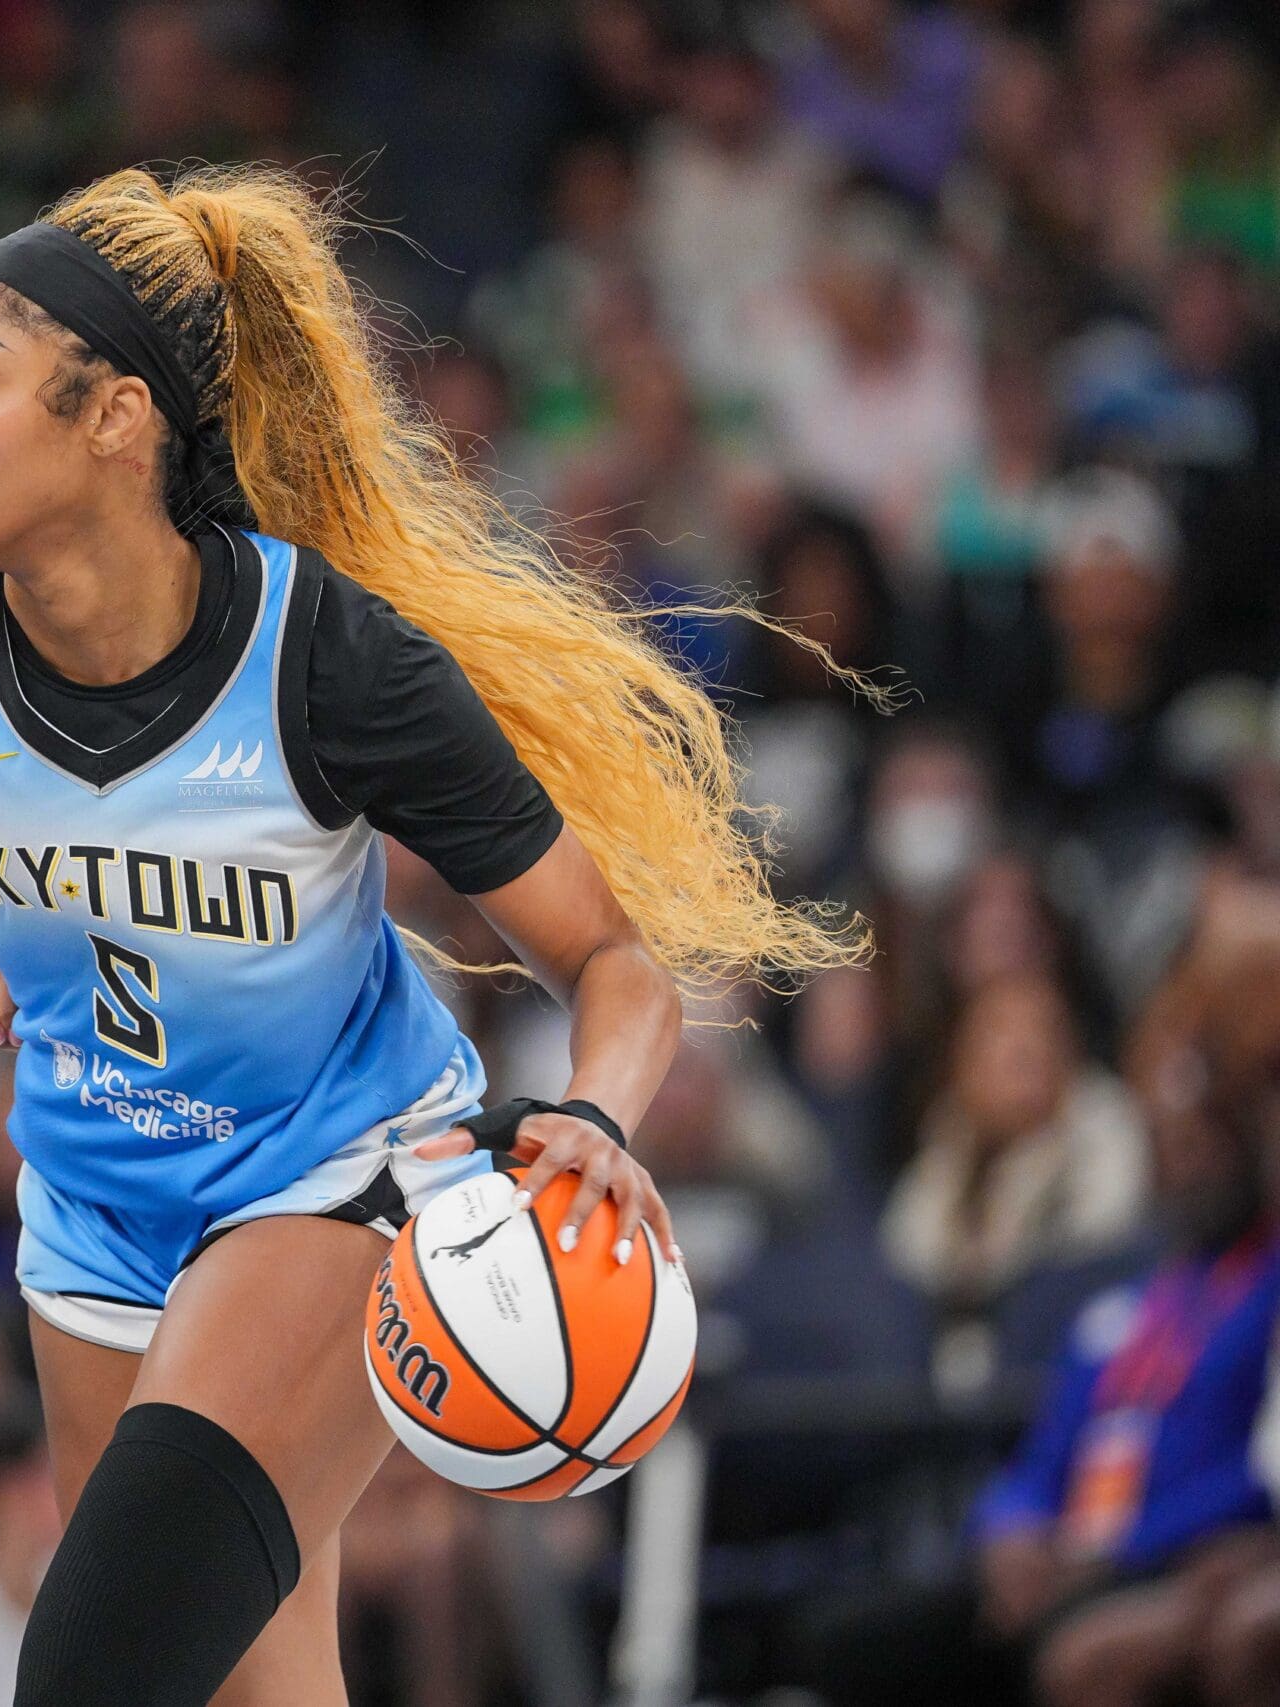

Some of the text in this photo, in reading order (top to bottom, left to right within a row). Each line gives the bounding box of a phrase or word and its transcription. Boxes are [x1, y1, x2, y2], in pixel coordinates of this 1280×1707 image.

[178, 784, 264, 797] MAGELLAN
[85, 930, 167, 1069] 5
[80, 1083, 235, 1143] Medicine
[92, 1053, 239, 1124] UChicago
